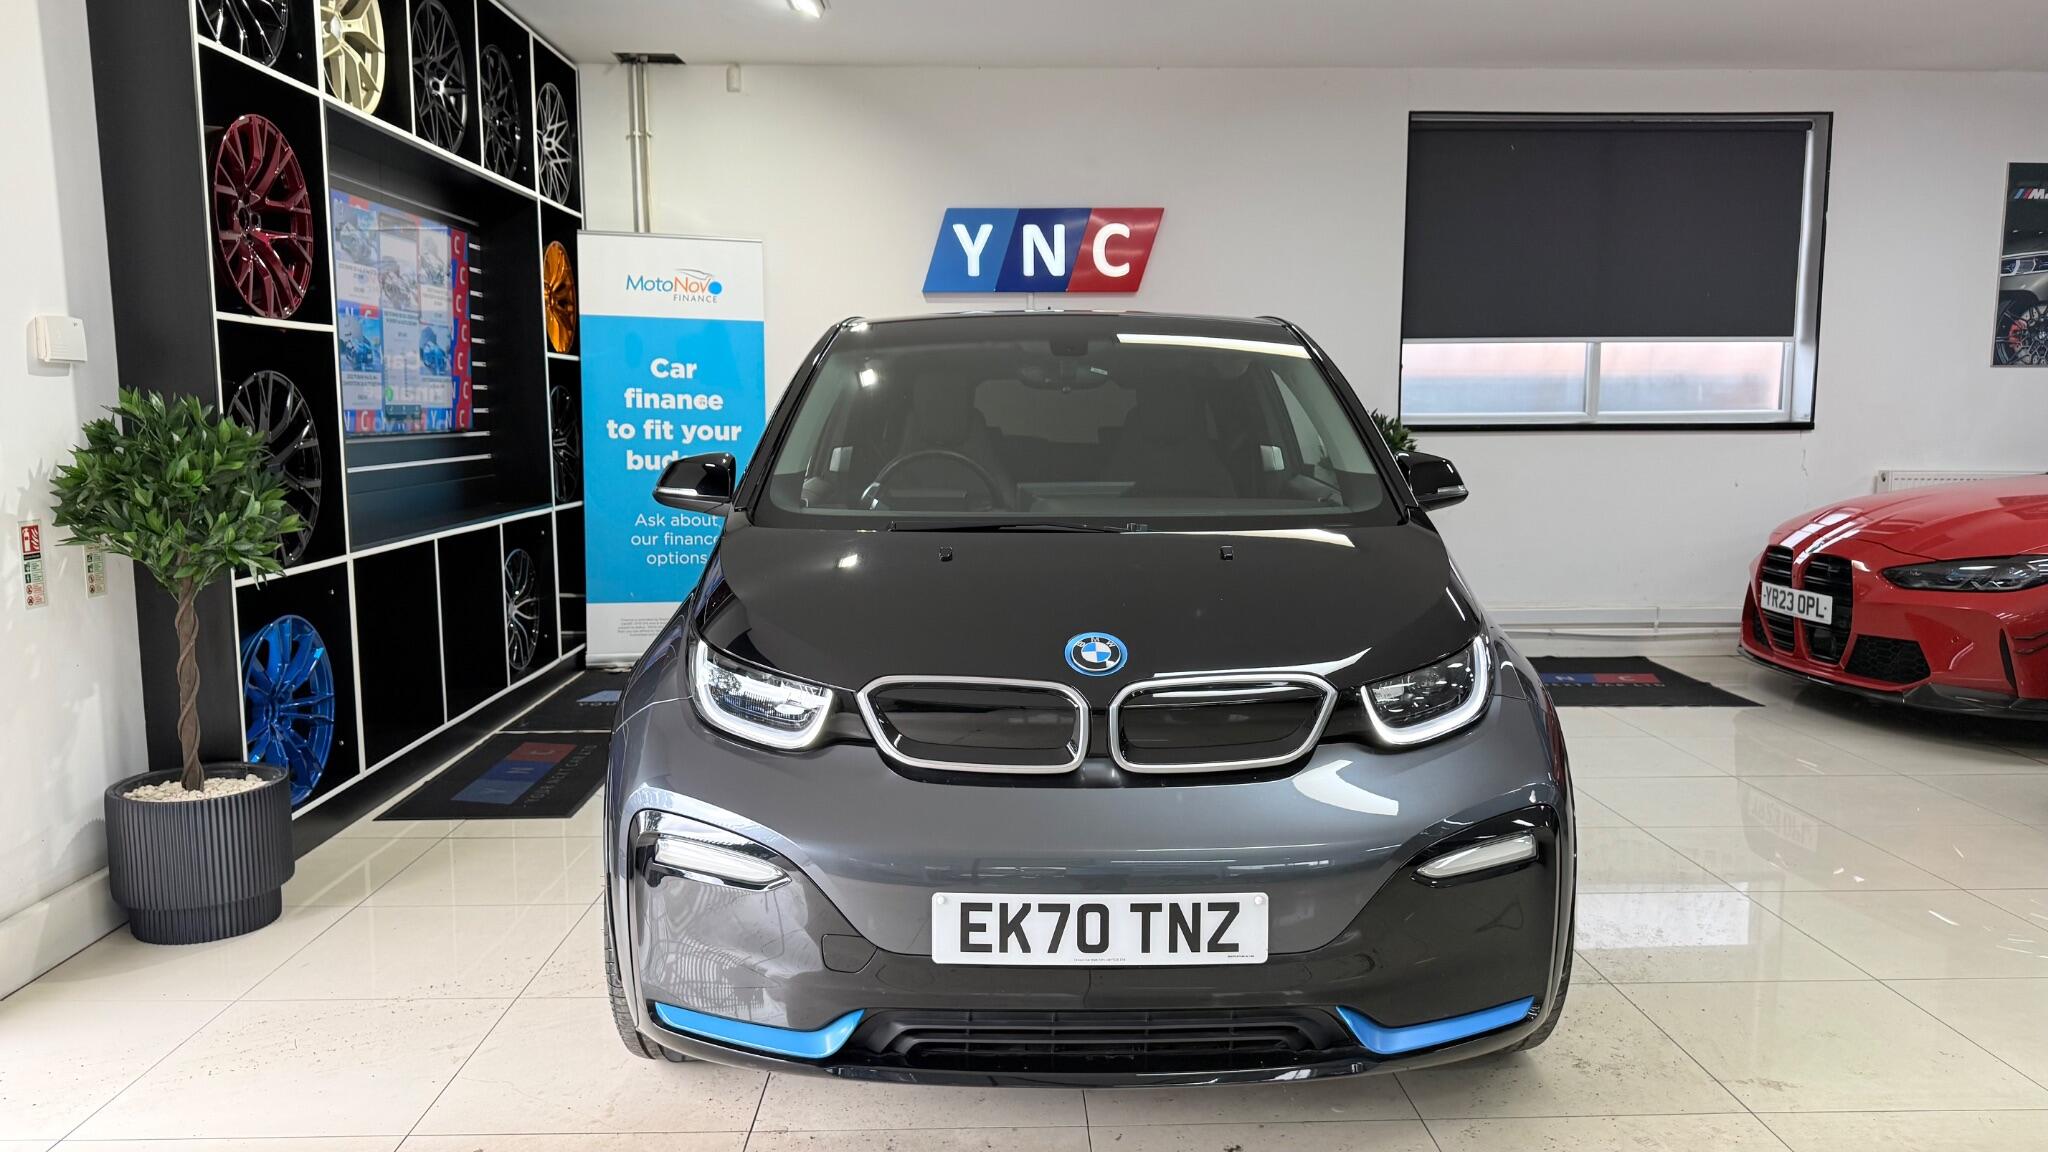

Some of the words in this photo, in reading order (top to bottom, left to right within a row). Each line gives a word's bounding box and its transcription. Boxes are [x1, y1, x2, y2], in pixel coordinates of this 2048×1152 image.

[952, 223, 1131, 278] YNC
[673, 293, 718, 304] FINANCE
[650, 358, 698, 379] Car
[624, 388, 724, 410] finance
[606, 419, 636, 439] to
[643, 419, 674, 440] fit
[681, 424, 742, 444] your
[635, 513, 666, 527] Ask
[670, 514, 718, 527] about
[631, 534, 658, 546] our
[647, 551, 709, 567] options
[1765, 585, 1795, 612] YR23
[1797, 593, 1825, 619] OPL
[1076, 637, 1116, 648] BMW
[959, 901, 1111, 955] EK70
[1129, 901, 1241, 954] TNZ
